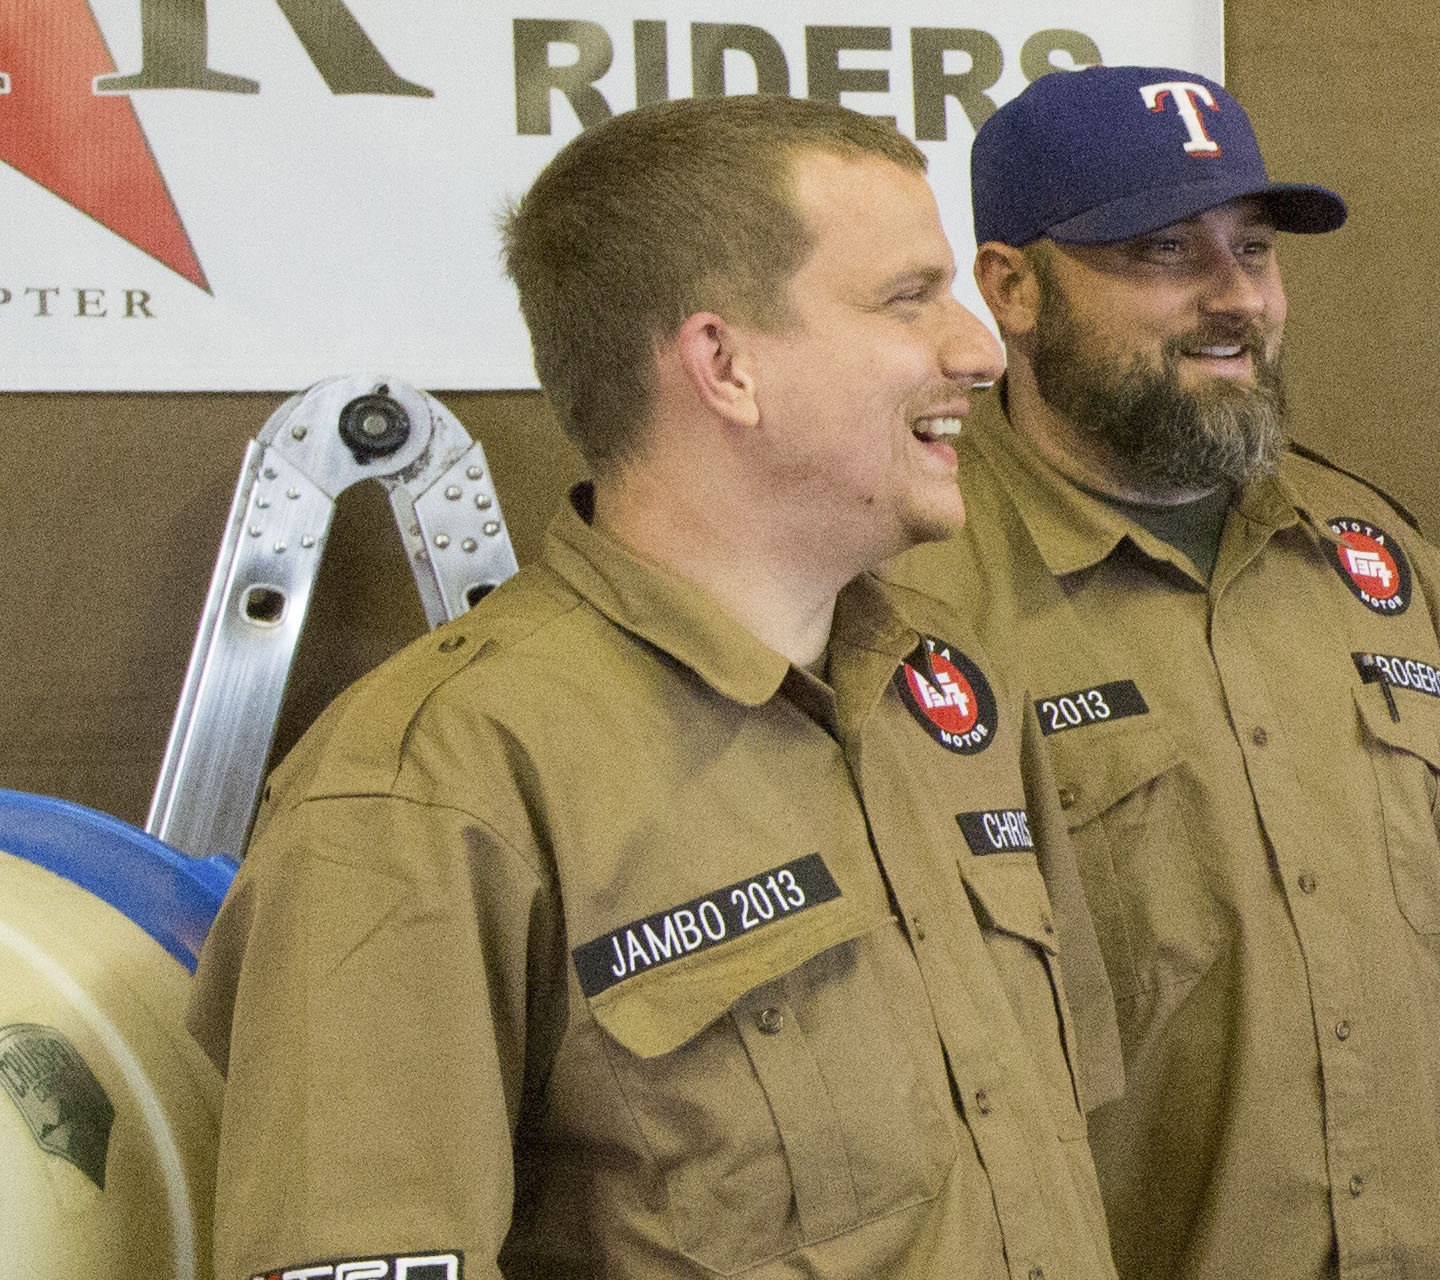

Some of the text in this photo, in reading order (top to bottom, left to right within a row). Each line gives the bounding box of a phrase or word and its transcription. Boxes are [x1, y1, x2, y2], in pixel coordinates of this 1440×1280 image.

[1138, 80, 1222, 158] T
[1331, 521, 1385, 546] OYOTA
[1361, 589, 1403, 610] MOTOR
[1042, 690, 1111, 731] 2013
[940, 723, 989, 748] MOTOR
[610, 867, 806, 977] JAMBO 2013
